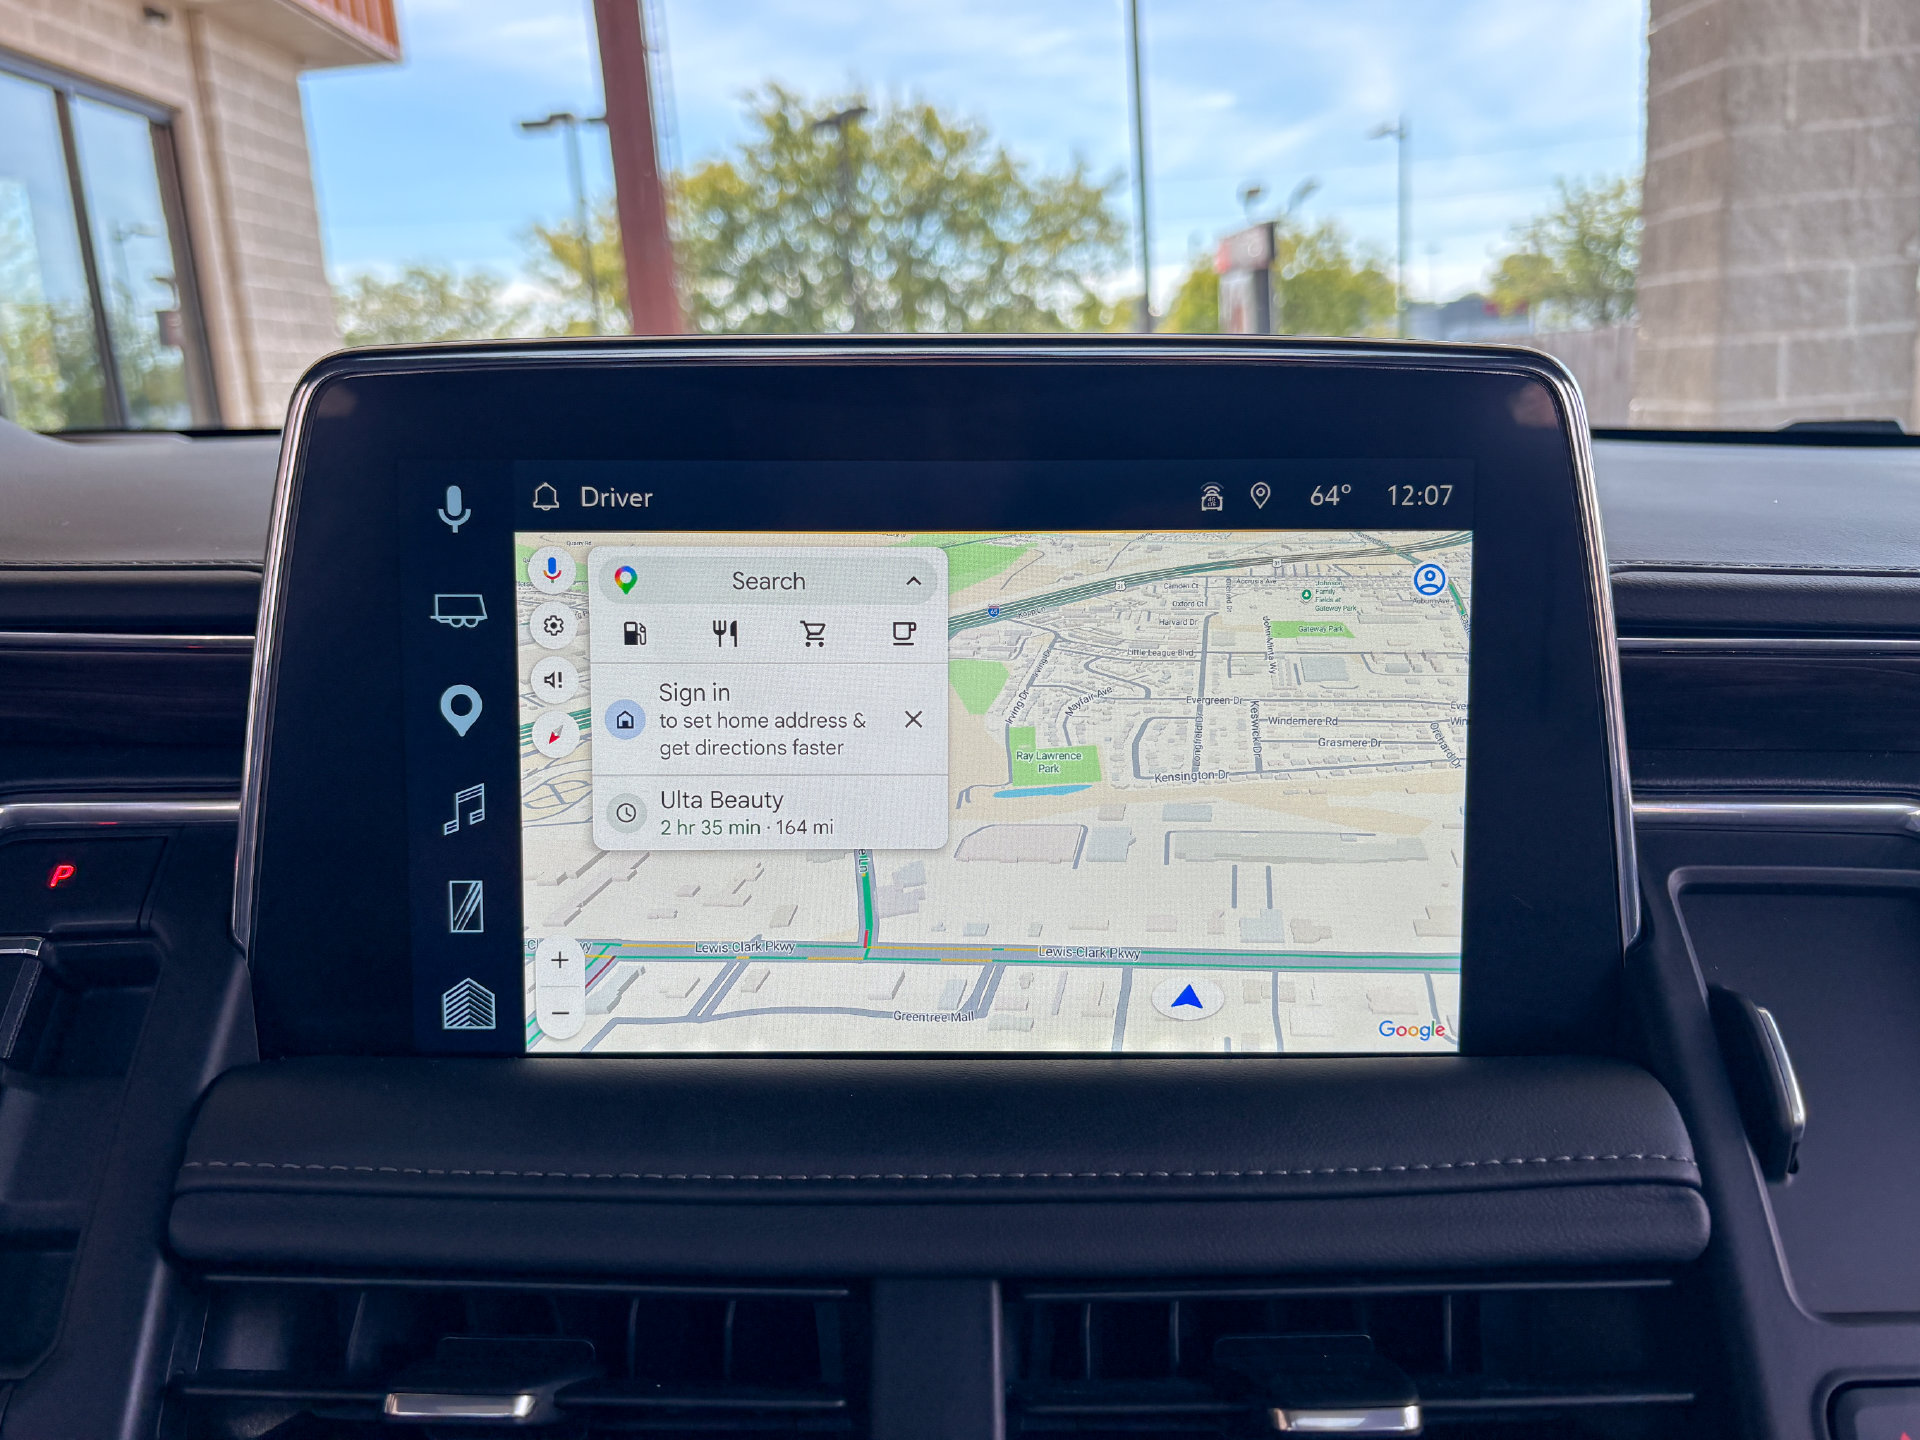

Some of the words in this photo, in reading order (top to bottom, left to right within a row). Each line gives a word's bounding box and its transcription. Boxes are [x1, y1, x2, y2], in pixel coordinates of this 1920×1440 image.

[581, 486, 653, 508] Driver
[1310, 484, 1352, 506] 64°
[1388, 484, 1454, 506] 12:07
[732, 571, 806, 590] Search
[1159, 618, 1187, 626] Harvard
[1189, 618, 1198, 626] Dr
[1298, 625, 1327, 633] Gateway
[1147, 648, 1175, 658] League
[1177, 648, 1194, 657] Blvd
[659, 683, 706, 706] Sign
[711, 683, 730, 701] in
[1064, 693, 1095, 717] Mayfair
[1097, 686, 1113, 698] Ave
[1186, 696, 1230, 705] Evergreen
[1233, 696, 1243, 705] Dr
[1005, 699, 1026, 725] Irving
[1018, 689, 1030, 700] Dr
[1450, 700, 1467, 710] Eve
[660, 714, 679, 729] to
[683, 714, 712, 729] set
[716, 711, 768, 729] home
[774, 711, 847, 729] address
[853, 712, 867, 729] &
[1250, 700, 1261, 743] Keswick
[1325, 716, 1338, 726] Rd
[659, 741, 691, 761] get
[695, 739, 787, 756] directions
[792, 739, 845, 756] faster
[1318, 737, 1368, 748] Grasmere
[1370, 738, 1382, 748] Dr
[1430, 722, 1456, 759] Orchard
[1451, 757, 1462, 769] Dr
[1016, 751, 1034, 762] Ray
[1036, 751, 1082, 761] Lawrence
[1253, 746, 1262, 758] Dr
[1038, 764, 1060, 773] Park
[1154, 770, 1215, 783] Kensington
[1218, 770, 1230, 780] Dr
[660, 790, 703, 809] Ulta
[710, 790, 784, 813] Beauty
[661, 820, 672, 836] 2
[677, 819, 696, 836] hr
[701, 820, 723, 836] 35
[729, 820, 761, 836] min
[776, 820, 808, 836] 164
[813, 820, 834, 836] mi
[50, 865, 75, 888] P
[695, 941, 762, 954] Lewis-Clark
[765, 941, 795, 955] Pkwy
[1038, 946, 1107, 958] Lewis-Clark
[1110, 946, 1141, 961] Pkwy
[893, 1010, 947, 1022] Greentree
[950, 1010, 975, 1023] Mall
[1378, 1020, 1446, 1043] Google
